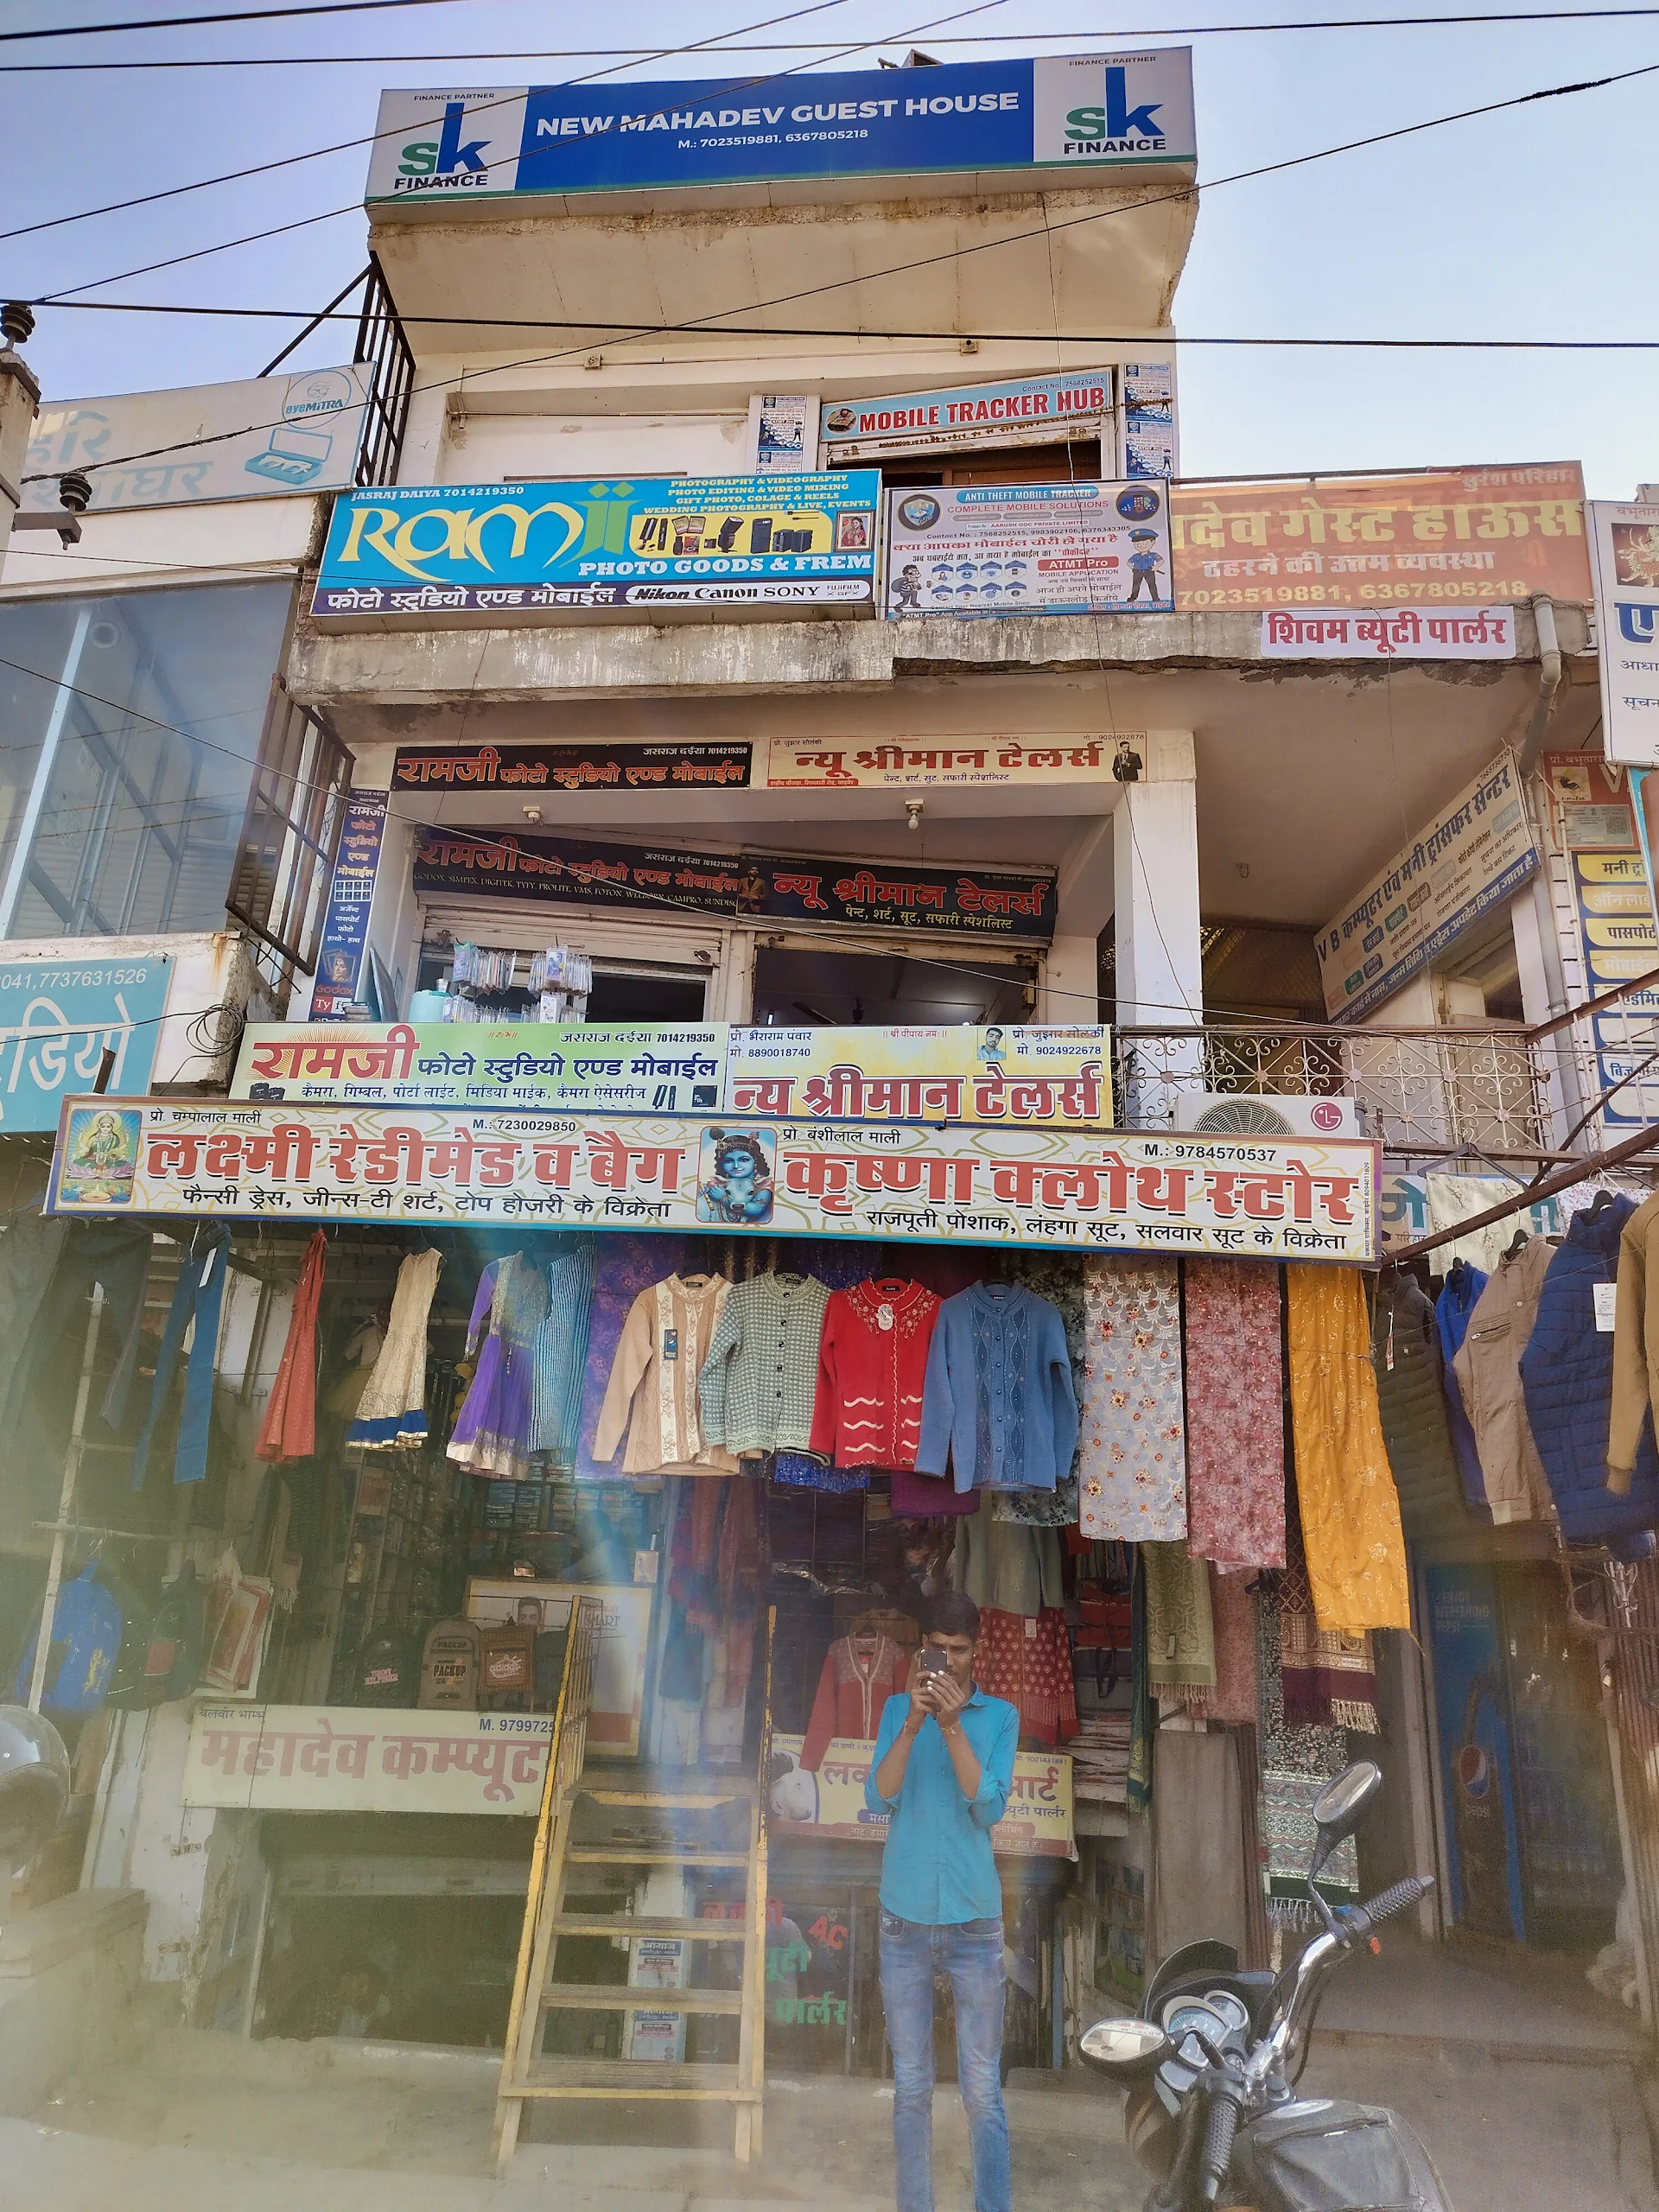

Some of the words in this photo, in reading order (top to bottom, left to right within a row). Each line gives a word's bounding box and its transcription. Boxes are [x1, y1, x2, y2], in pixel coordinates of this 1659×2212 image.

[1069, 58, 1109, 67] FINANCE
[1112, 56, 1156, 65] PARTNER
[454, 92, 495, 100] PARTNER
[537, 115, 613, 137] NEW
[619, 106, 784, 134] MAHADEV
[791, 99, 899, 125] GUEST
[905, 92, 1020, 116] HOUSE
[785, 129, 868, 143] 6367805218
[1064, 139, 1166, 155] FINANCE
[393, 174, 489, 190] FINANCE
[1022, 384, 1049, 393] Contact
[1065, 377, 1105, 388] 7568252515
[858, 404, 940, 434] MOBILE
[946, 391, 1050, 424] TRACKER
[1056, 385, 1105, 413] HUB
[671, 478, 755, 487] PHOTOGRAPHY
[766, 474, 848, 485] VIDEOGRAPHY
[351, 490, 397, 502] JASRAJ
[399, 488, 441, 499] DAIYA
[443, 486, 524, 498] 7014219350
[667, 486, 706, 496] PHOTO
[708, 486, 755, 495] EDITING
[766, 485, 802, 493] VIDEO
[804, 483, 849, 492] MIXING
[965, 491, 985, 501] ANTI
[987, 490, 1013, 500] THEFT
[1015, 489, 1049, 499] MOBILE
[1050, 488, 1091, 499] TRACKER
[747, 493, 791, 503] COLAGE
[804, 493, 839, 501] REELS
[643, 506, 698, 515] WEDDING
[700, 503, 785, 512] PHOTOGRAPHY
[828, 499, 871, 508] EVENTS
[947, 504, 1003, 514] COMPLETE
[1007, 502, 1046, 512] MOBILE
[1048, 500, 1109, 510] SOLUTIONS
[1412, 499, 1582, 541] हाऊस
[578, 559, 668, 577] PHOTO
[674, 556, 765, 574] GOODS
[794, 554, 872, 570] FREM
[1048, 559, 1084, 569] ATMT
[1086, 558, 1109, 568] Pro
[1394, 550, 1496, 571] व्यवस्था
[327, 587, 385, 609] फोटो
[476, 590, 524, 608] एण्ड
[633, 588, 690, 601] Nikon
[694, 588, 759, 600] Canon
[763, 586, 821, 597] SONY
[1360, 580, 1529, 600] 6367805218
[1267, 610, 1351, 645] शिवम
[1355, 612, 1421, 653] ब्यूटी
[1427, 608, 1507, 644] पार्लर
[643, 746, 678, 756] जसराज
[707, 746, 748, 754] 7014219350
[397, 746, 502, 783] रामजी
[499, 762, 548, 784] फोटो
[552, 760, 621, 789] स्टुडियो
[625, 766, 668, 785] एण्ड
[671, 760, 746, 784] मोबाईल
[794, 752, 853, 778] न्यू
[852, 745, 989, 771] श्रीमान
[996, 741, 1104, 768] टेलर्स
[883, 773, 902, 784] पेन्ट,
[905, 772, 921, 783] शर्ट,
[942, 772, 967, 782] सफारी
[969, 772, 1010, 781] स्पेशलिस्ट
[348, 804, 387, 818] रामजी
[350, 819, 377, 831] फोटो
[346, 851, 371, 862] एण्ड
[418, 835, 522, 872] रामजी
[518, 855, 564, 875] फोटो
[632, 866, 671, 887] एण्ड
[674, 867, 739, 893] मोबाईल
[644, 852, 676, 862] जसराज
[702, 859, 740, 869] 7014219350
[336, 865, 375, 879] मोबाईल
[1601, 859, 1629, 874] मनी
[772, 872, 830, 911] न्यू
[832, 870, 948, 909] श्रीमान
[955, 877, 1050, 917] टेलर्स
[1316, 939, 1327, 963] V
[1330, 930, 1340, 953] B
[1402, 845, 1427, 882] मनी
[1387, 966, 1406, 984] जन्म
[1450, 902, 1478, 932] अपडेट
[1476, 882, 1502, 910] किया
[1500, 864, 1525, 889] जाता
[1523, 854, 1534, 870] है
[315, 984, 353, 995] Godox
[560, 1032, 613, 1043] जसराज
[656, 1033, 715, 1044] 7014219350
[729, 1030, 746, 1042] प्रो.
[889, 1028, 899, 1039] श्री
[251, 1024, 421, 1081] रामजी
[416, 1051, 477, 1077] फोटो
[482, 1051, 567, 1084] स्टुडियो
[573, 1058, 624, 1081] एण्ड
[630, 1052, 719, 1081] मोबाईल
[729, 1046, 746, 1058] मो.
[747, 1046, 811, 1058] 8890018740
[1036, 1046, 1103, 1056] 9024922678
[800, 1063, 967, 1119] श्रीमान
[972, 1061, 1105, 1120] टेलर्स
[150, 1107, 166, 1122] प्रो.
[172, 1109, 227, 1123] चम्पालाल
[232, 1109, 262, 1123] माली
[472, 1118, 493, 1130] M.:
[497, 1117, 576, 1132] 7230029850
[782, 1125, 802, 1142] प्रो.
[807, 1126, 863, 1143] बंशीलाल
[868, 1128, 901, 1145] माली
[146, 1122, 321, 1185] लक्ष्मी
[328, 1124, 524, 1190] रेडीमेड
[532, 1142, 581, 1191] व
[582, 1130, 687, 1195] बैग
[1175, 1144, 1277, 1162] 9784570537
[782, 1151, 981, 1217] कृष्णा
[989, 1149, 1194, 1218] क्लोथ
[1205, 1158, 1360, 1226] स्टोर
[182, 1184, 240, 1205] फैन्सी
[248, 1185, 292, 1210] ड्रेस,
[401, 1191, 444, 1213] शर्ट,
[454, 1191, 493, 1212] टोप
[501, 1192, 565, 1215] होजरी
[574, 1194, 596, 1215] के
[604, 1195, 673, 1218] विक्रेता
[866, 1208, 938, 1233] राजपूती
[946, 1211, 1017, 1236] पोशाक,
[1086, 1221, 1127, 1247] सूट,
[1135, 1224, 1204, 1243] सलवार
[1211, 1226, 1247, 1251] सूट
[1254, 1225, 1274, 1246] के
[1282, 1227, 1348, 1251] विक्रेता
[433, 1663, 467, 1678] PACKUP
[478, 1718, 495, 1732] M.
[200, 1716, 376, 1780] महादेव
[1033, 1804, 1066, 1819] पार्लर
[807, 1914, 849, 1950] AC
[775, 1990, 848, 2025] पार्लर
